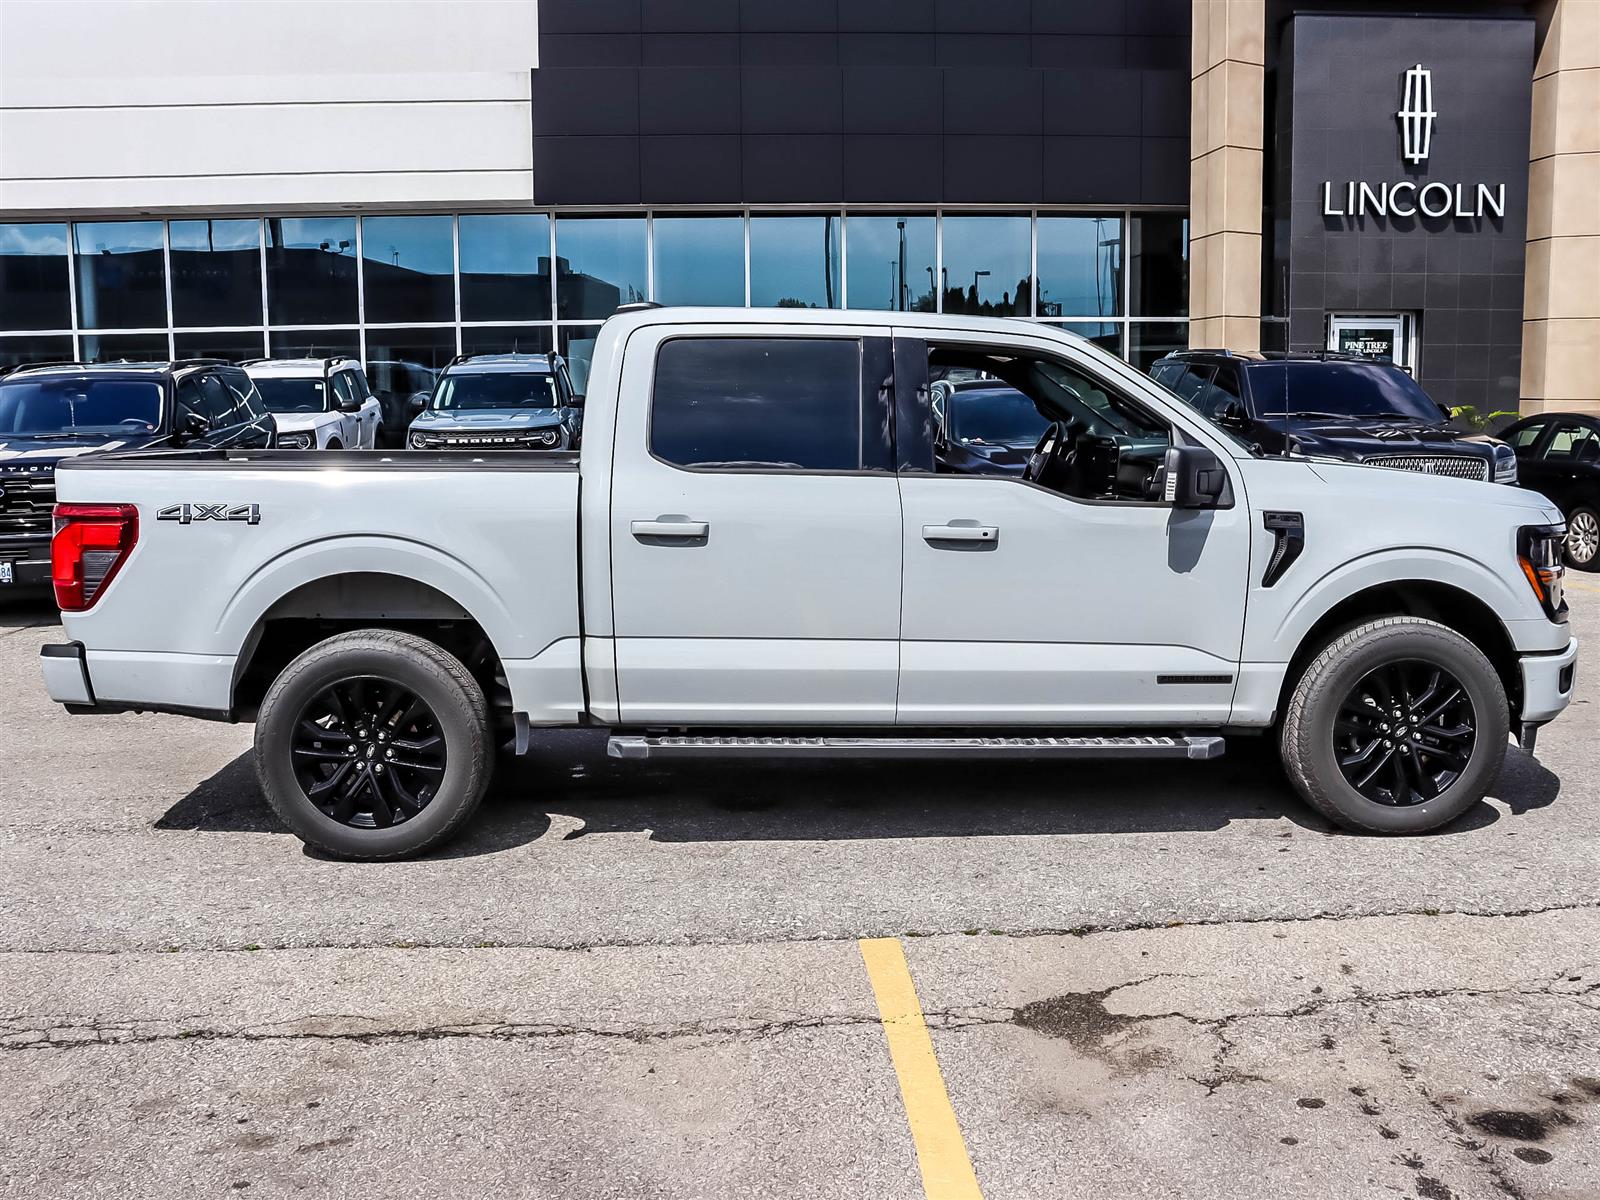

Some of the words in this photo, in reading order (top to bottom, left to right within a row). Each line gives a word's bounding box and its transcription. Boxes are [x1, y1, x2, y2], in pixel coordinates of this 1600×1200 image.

[1324, 181, 1506, 217] LINCOLN
[1345, 341, 1365, 349] PINE
[1366, 341, 1388, 349] TREE
